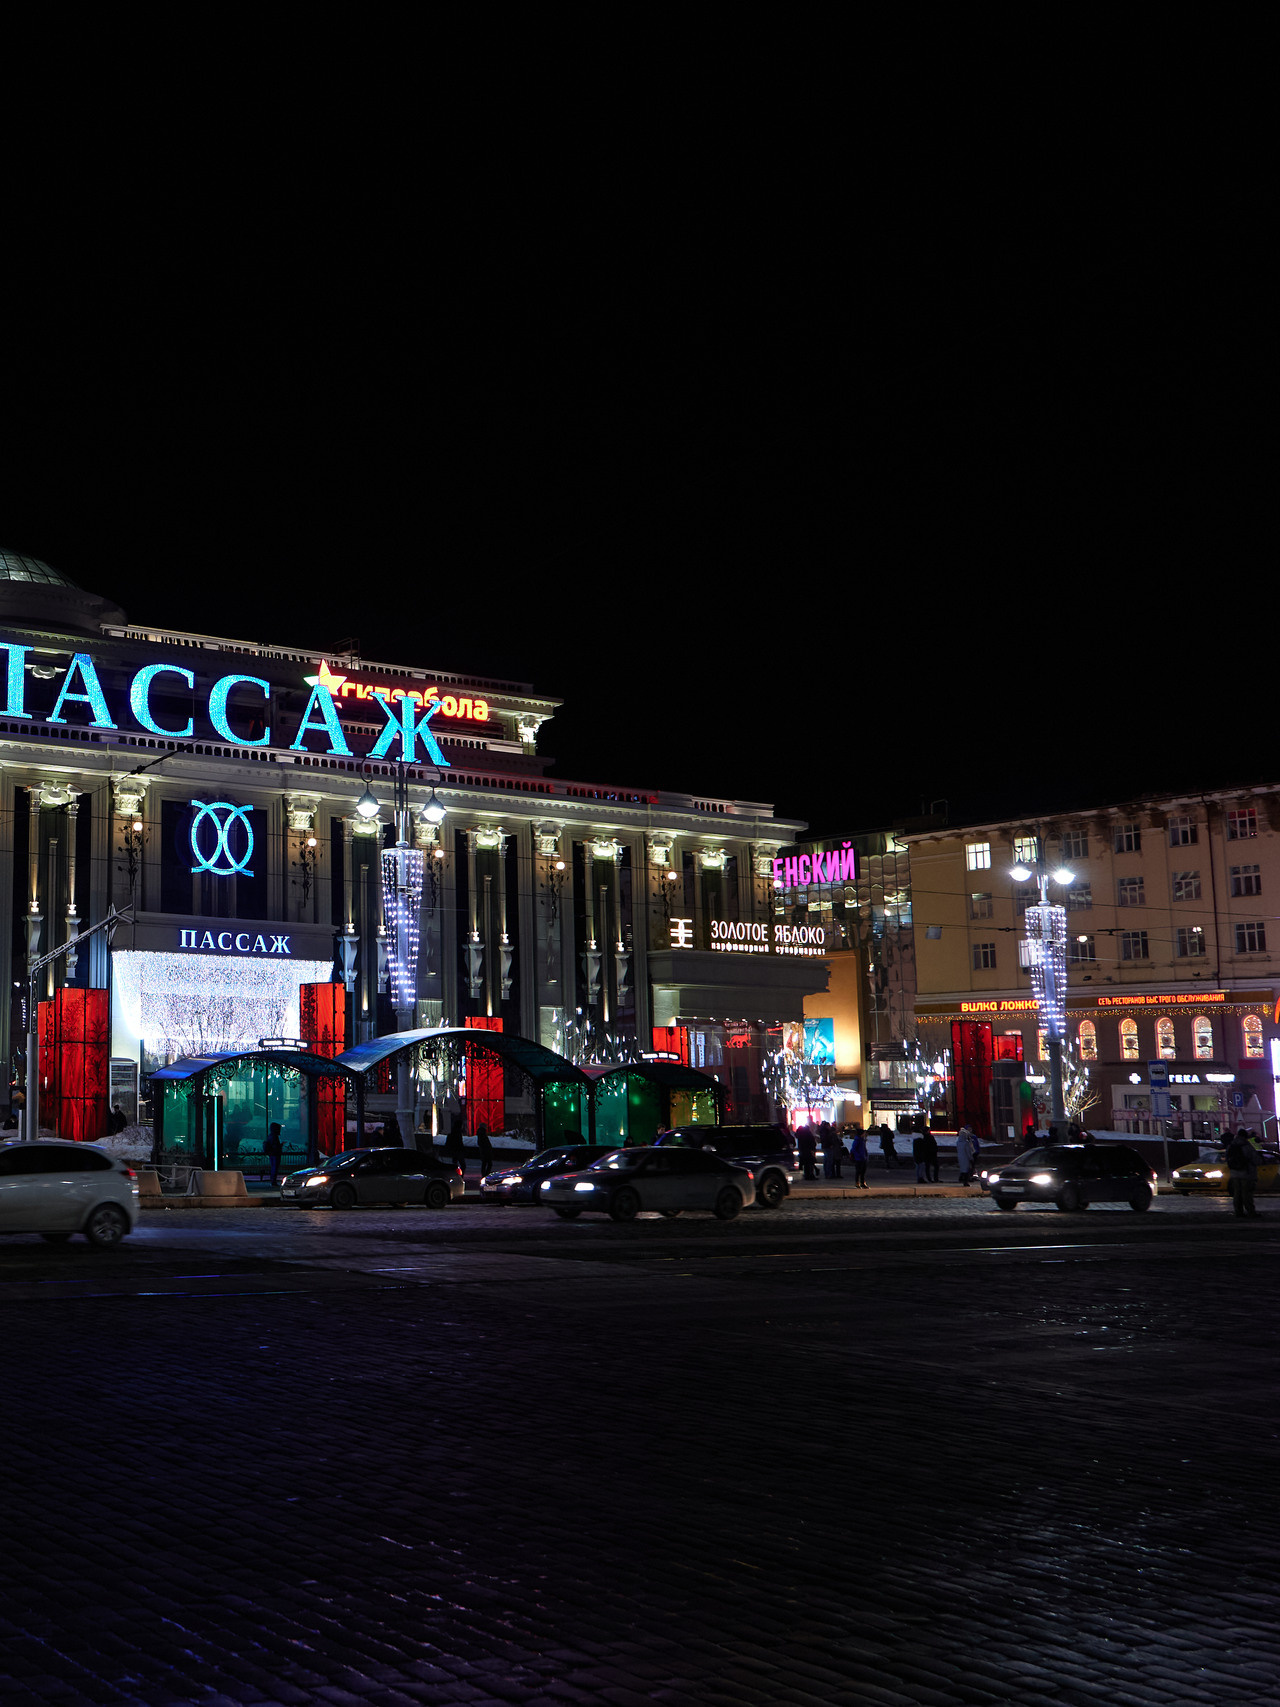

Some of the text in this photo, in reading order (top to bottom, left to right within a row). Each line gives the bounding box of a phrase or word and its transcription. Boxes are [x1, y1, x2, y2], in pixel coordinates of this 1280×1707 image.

[179, 929, 291, 953] ПАССАЖ
[710, 920, 825, 944] ЗОЛОТОЕ ЯБЛОКО
[1098, 997, 1112, 1006] СЕТЬ
[1112, 996, 1146, 1005] РЕСТОРАНОВ
[1177, 993, 1225, 1003] ОБСЛУЖИВАНИЯ
